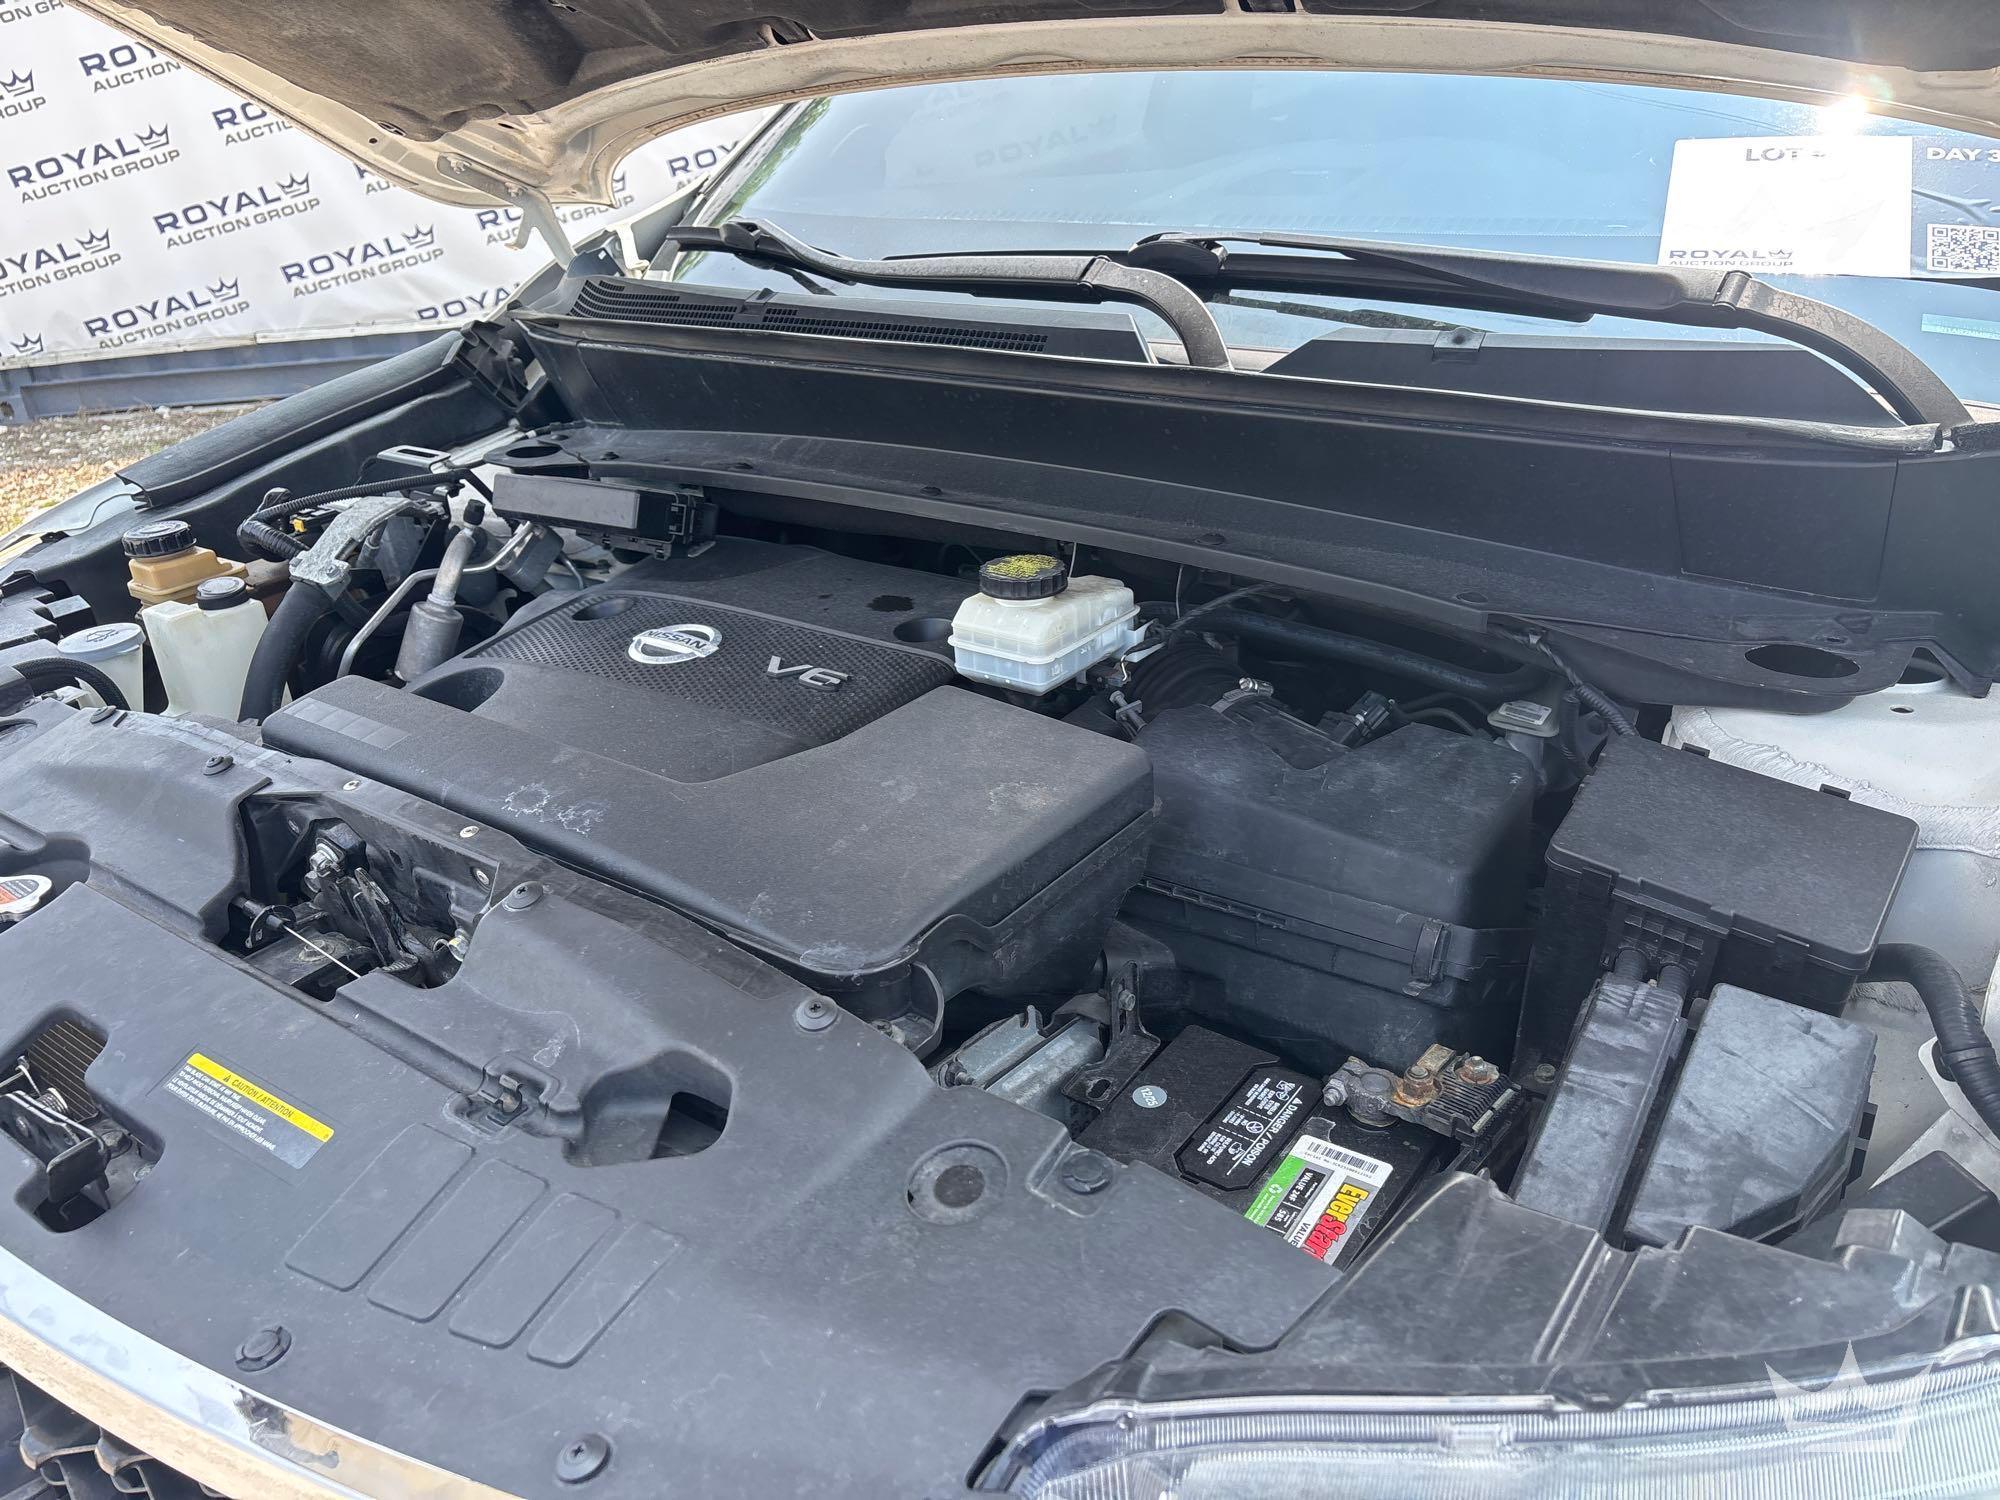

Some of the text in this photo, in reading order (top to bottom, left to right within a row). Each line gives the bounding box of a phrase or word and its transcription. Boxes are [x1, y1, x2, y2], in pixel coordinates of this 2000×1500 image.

[7, 138, 140, 188] ROYAL
[1926, 147, 1982, 160] DAY
[22, 149, 180, 203] AUCTION GROUP
[152, 186, 282, 234] ROYAL
[167, 198, 320, 249] AUCTION GROUP
[53, 253, 122, 281] GROUP
[281, 237, 406, 283] ROYAL
[1669, 250, 1766, 259] ROYAL
[294, 248, 444, 298] AUCTION GROUP
[84, 291, 211, 337] ROYAL
[100, 301, 250, 350] AUCTION GROUP
[648, 629, 707, 650] NISSAN
[766, 655, 850, 692] V6
[230, 1079, 258, 1098] CAUTION
[258, 1095, 294, 1118] ATTENTION
[1139, 1087, 1159, 1107] 12/25
[1267, 1103, 1298, 1133] DANGER
[1263, 1131, 1275, 1139] /
[1240, 1137, 1270, 1166] POISON
[1287, 1170, 1313, 1201] VALUE 24F
[1273, 1208, 1287, 1222] 585
[1289, 1220, 1311, 1246] VALUE
